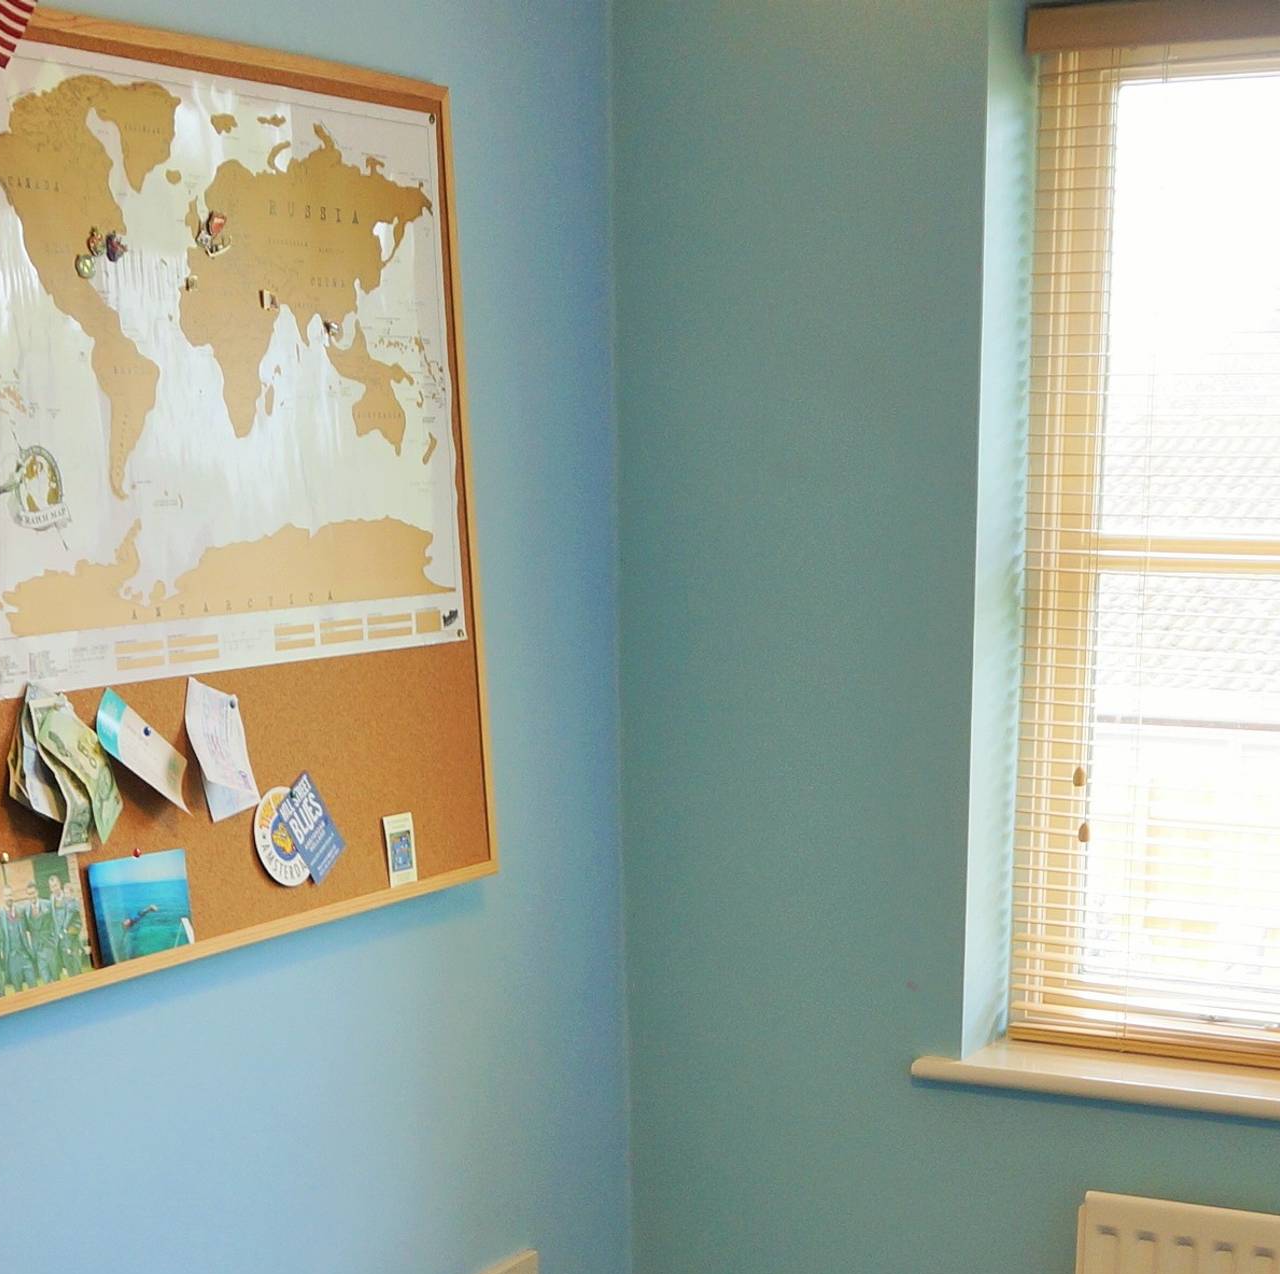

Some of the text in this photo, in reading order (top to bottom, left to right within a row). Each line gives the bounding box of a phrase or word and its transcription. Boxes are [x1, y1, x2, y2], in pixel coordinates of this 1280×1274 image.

[269, 200, 360, 224] RUSSIA
[292, 773, 312, 807] STREET
[289, 791, 324, 845] BLUES
